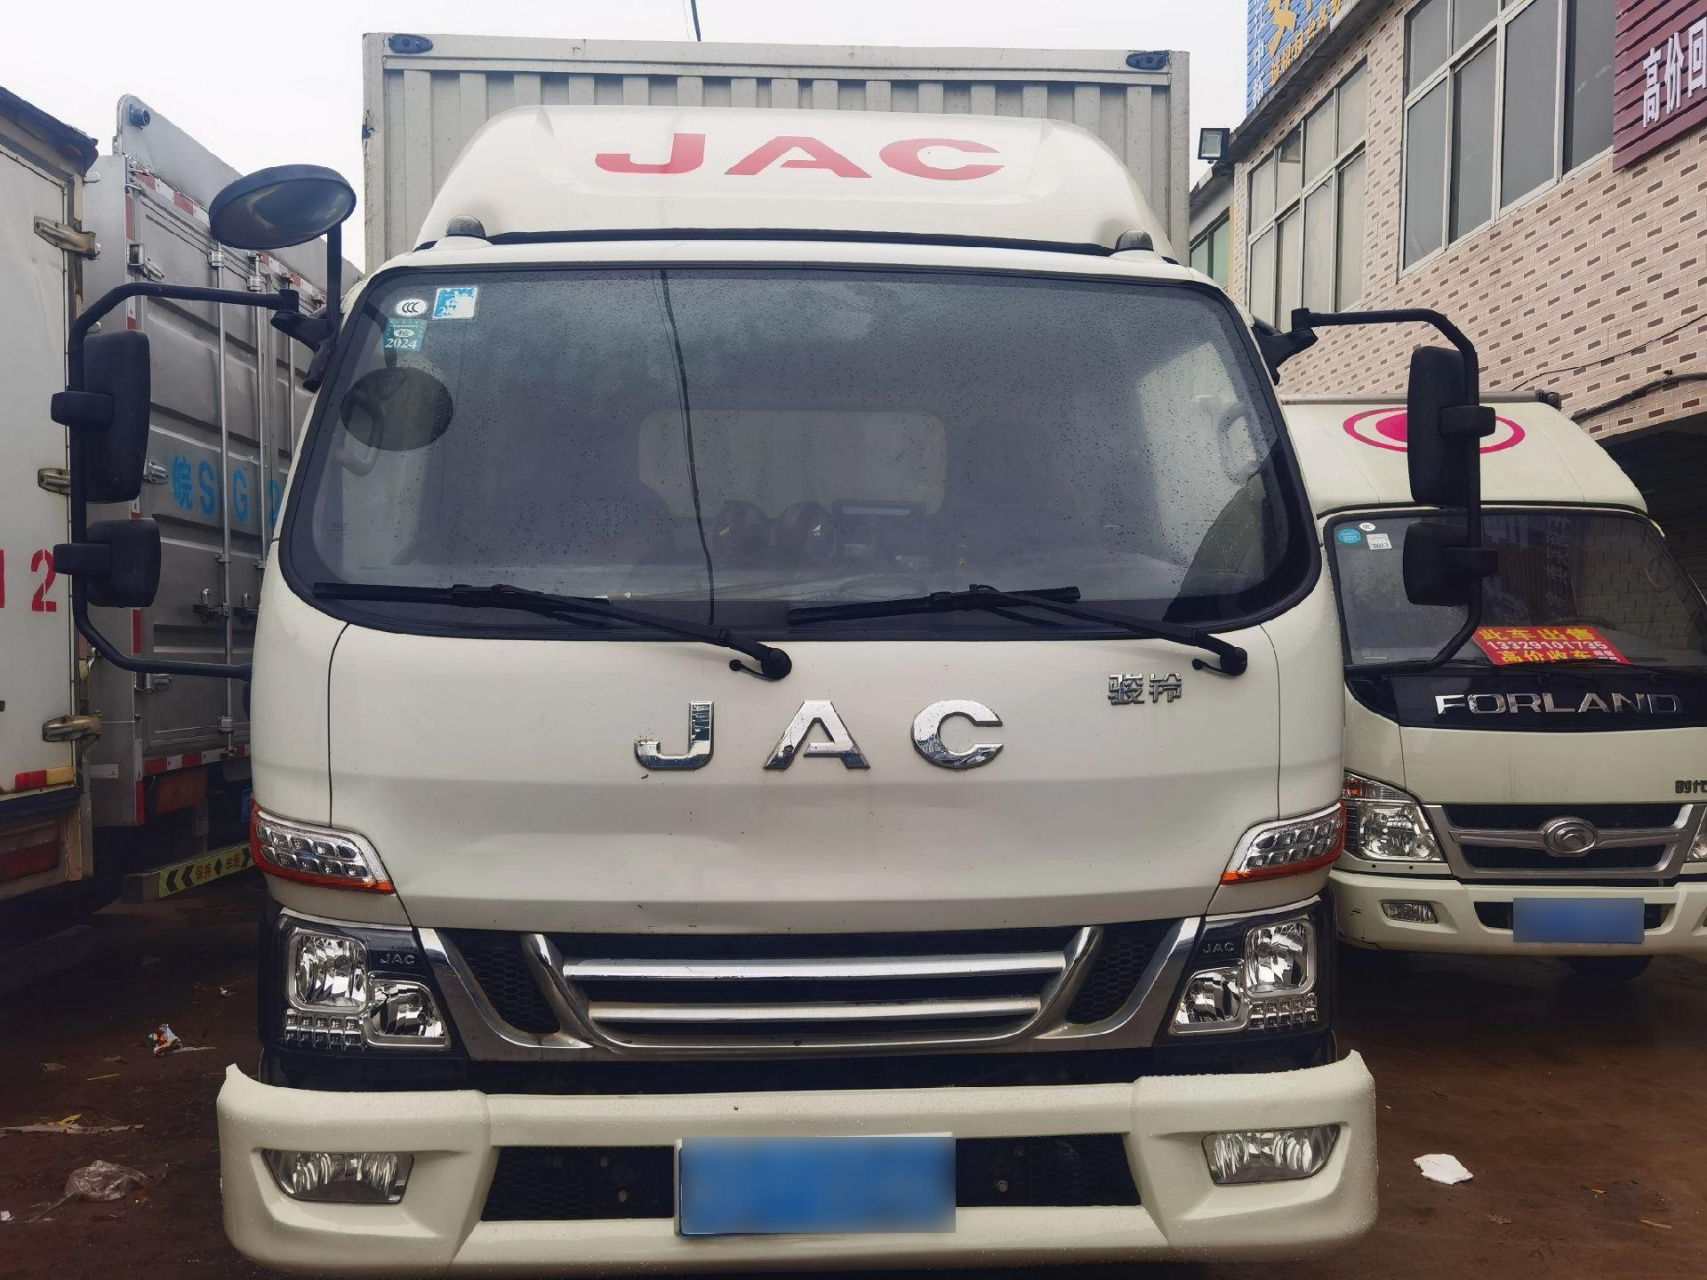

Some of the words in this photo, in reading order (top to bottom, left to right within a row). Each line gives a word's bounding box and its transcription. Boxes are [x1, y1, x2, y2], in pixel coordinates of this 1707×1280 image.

[1642, 17, 1707, 128] 高价回
[595, 133, 1005, 181] JAC
[384, 338, 418, 349] 2024
[1479, 627, 1595, 641] 此车出售
[1486, 641, 1608, 650] 13329101735
[1108, 672, 1183, 705] 骏铃
[1434, 693, 1680, 714] FORLAND
[634, 700, 1003, 770] JAC
[1203, 942, 1235, 954] JAC
[380, 953, 415, 965] JAC
